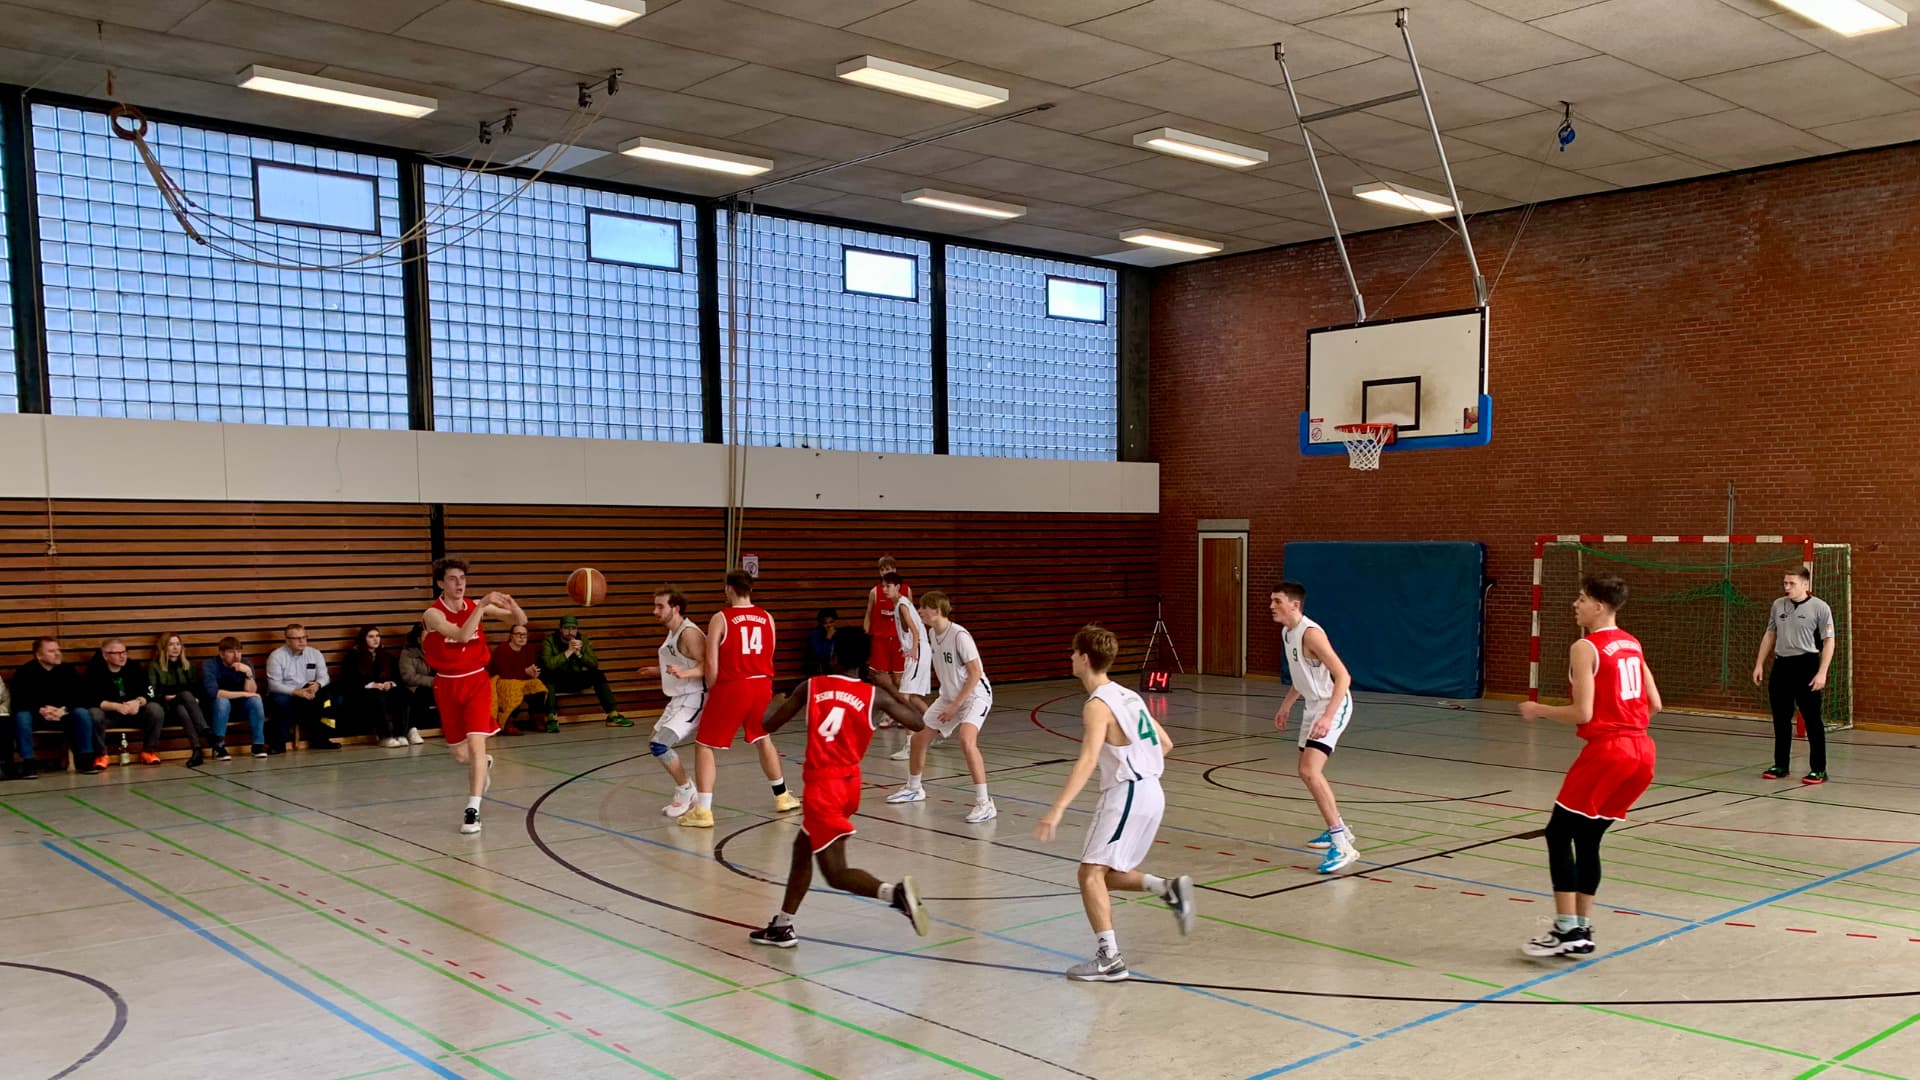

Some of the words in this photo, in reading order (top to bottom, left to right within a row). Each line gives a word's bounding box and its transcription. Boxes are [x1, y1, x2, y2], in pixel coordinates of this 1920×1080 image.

[740, 626, 763, 655] 14
[1292, 647, 1298, 662] 9
[943, 651, 953, 664] 16
[1149, 671, 1168, 688] 14
[1617, 656, 1642, 700] 10
[817, 706, 846, 742] 4
[1137, 709, 1159, 746] 4
